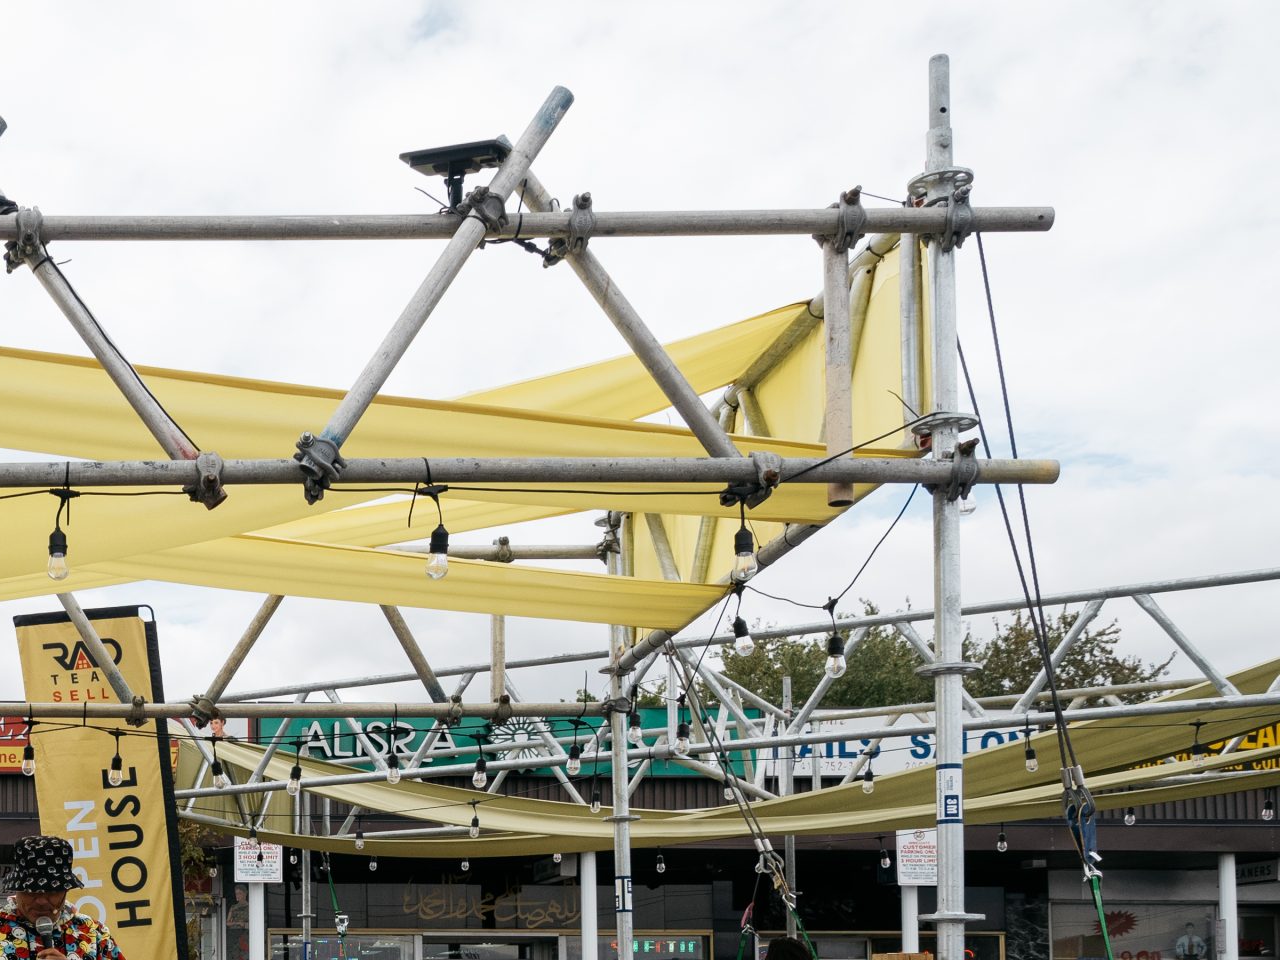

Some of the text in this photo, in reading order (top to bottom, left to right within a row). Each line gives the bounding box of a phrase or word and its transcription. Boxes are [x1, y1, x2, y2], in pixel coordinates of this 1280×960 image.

[43, 638, 122, 671] RAD
[51, 671, 100, 687] TEA
[53, 688, 110, 702] SELL
[101, 766, 153, 929] HOUSE
